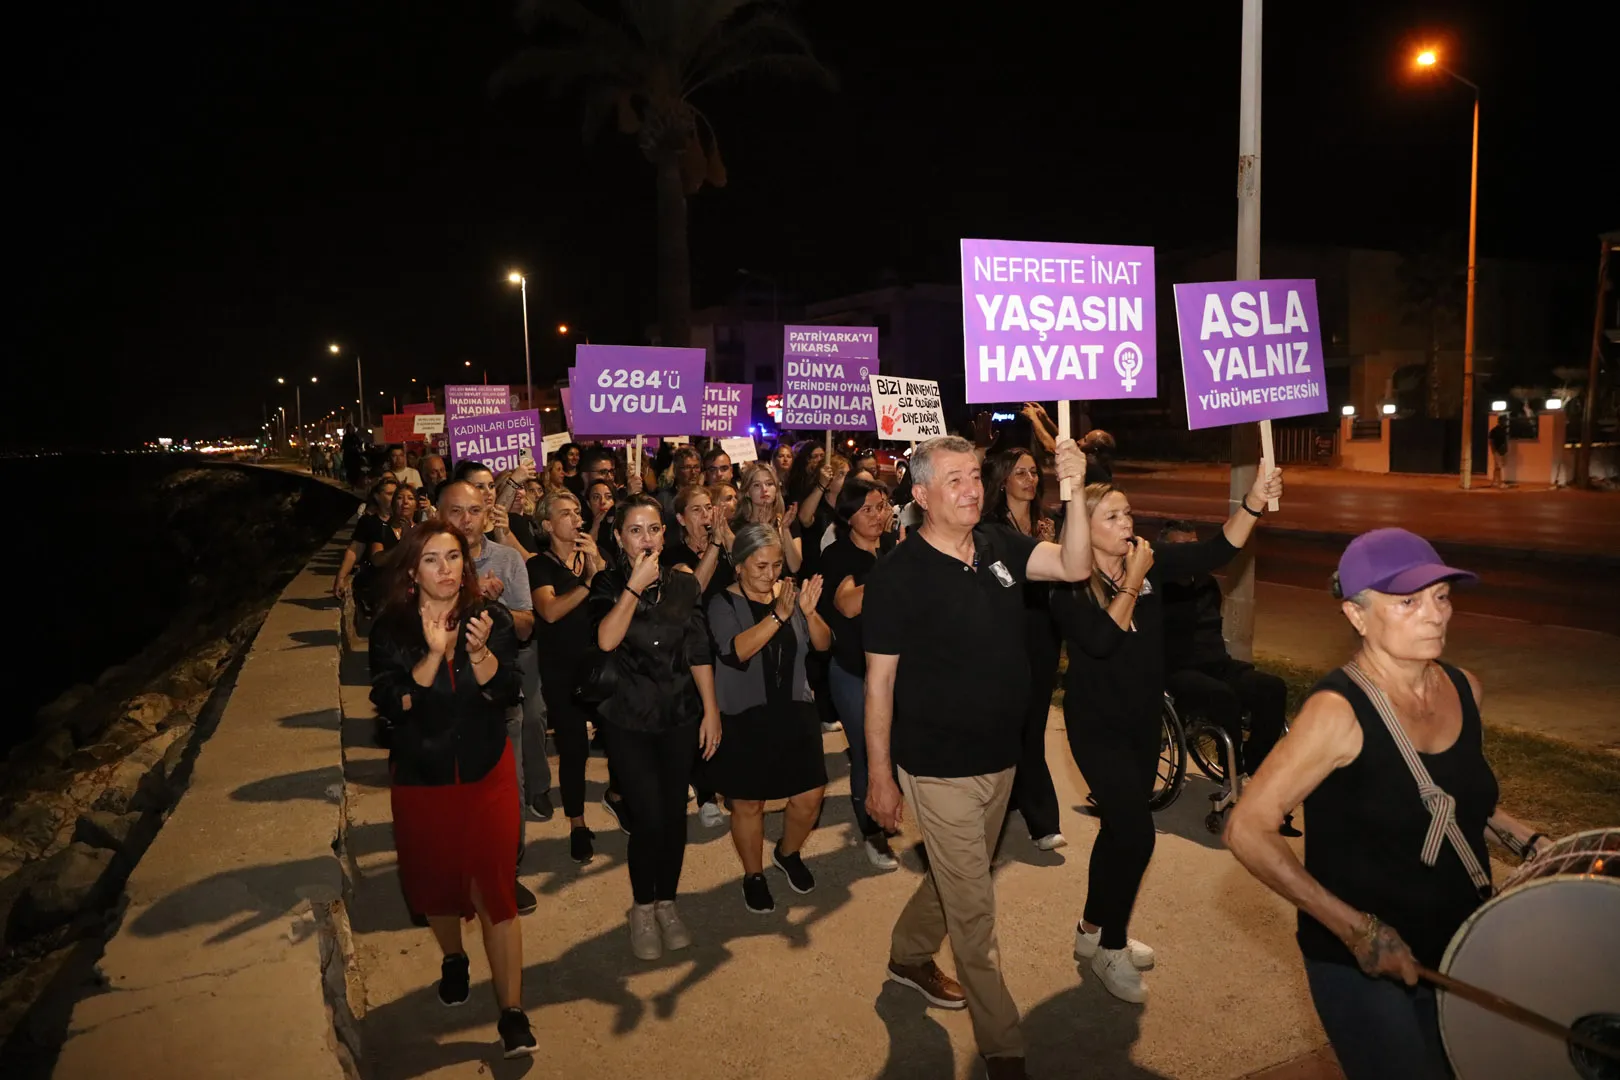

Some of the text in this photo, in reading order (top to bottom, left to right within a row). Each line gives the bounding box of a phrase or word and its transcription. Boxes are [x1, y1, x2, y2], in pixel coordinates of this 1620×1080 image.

[974, 255, 1142, 285] NEFRETE İNAT
[975, 294, 1143, 341] YAŞASIN
[1200, 290, 1309, 340] ASLA
[789, 330, 873, 343] PATRİYARKA'YI
[789, 342, 839, 353] YIKARSA
[787, 359, 845, 379] DÜNYA
[978, 345, 1104, 382] HAYAT
[1202, 341, 1311, 382] YALNIZ
[703, 386, 741, 402] İTLİK
[786, 379, 838, 392] YERİNDEN
[877, 379, 940, 397] BİZİ ANNEMİZ
[1198, 379, 1320, 410] YÜRÜMEYECEKSİN
[449, 397, 506, 405] İNADINA İSYAN
[457, 404, 501, 415] İNADINA
[589, 394, 687, 414] UYGULA
[786, 393, 873, 411] KADINLAR
[898, 397, 913, 408] SİZ
[454, 420, 506, 437] KADINLARI
[507, 415, 535, 429] DEĞİL
[701, 415, 732, 432] İMDİ
[785, 409, 868, 425] ÖZGÜR OLSA
[456, 427, 536, 458] FAİLLERİ
